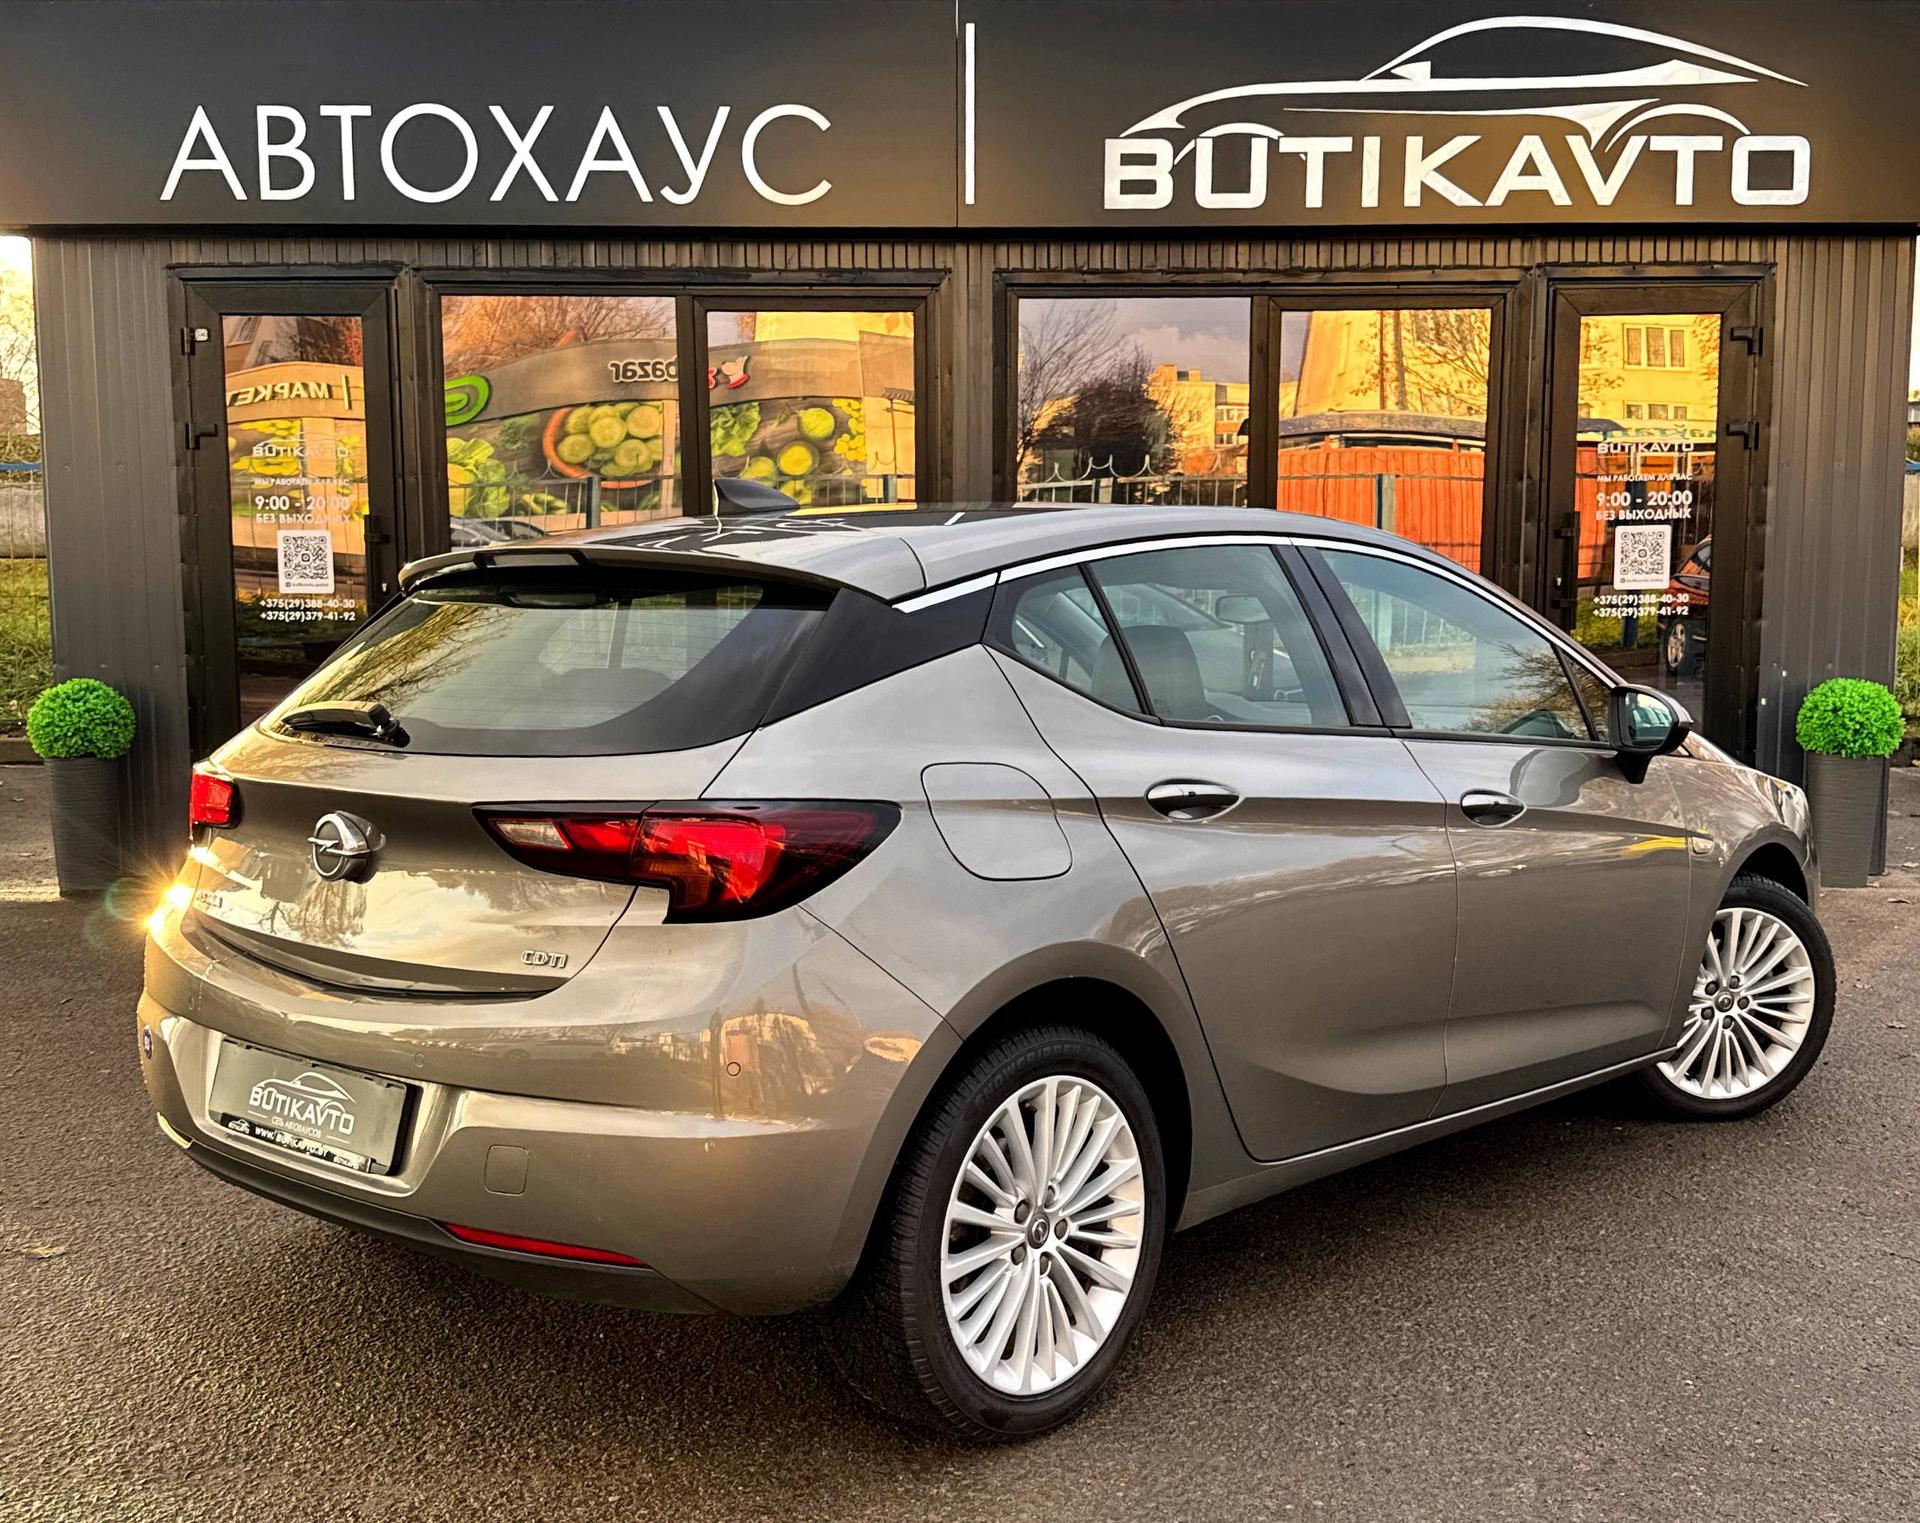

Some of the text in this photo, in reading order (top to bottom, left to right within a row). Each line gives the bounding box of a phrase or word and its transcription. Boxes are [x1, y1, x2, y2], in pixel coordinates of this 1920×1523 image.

[160, 103, 832, 205] АВТОХАУС
[1103, 135, 1811, 210] BUTIKAVTO
[1597, 441, 1694, 454] BUTIKAVTO
[255, 495, 290, 511] 9:00
[1596, 492, 1631, 507] 9:00
[1647, 490, 1693, 506] 20:00
[256, 514, 276, 524] БЕЗ
[1596, 508, 1691, 521] БЕЗ ВЫХОДНЫХ
[260, 611, 356, 622] +375(29)379-41-92
[1593, 606, 1689, 619] +375(29)379-41-92
[249, 1086, 355, 1135] BUTIKAVTO
